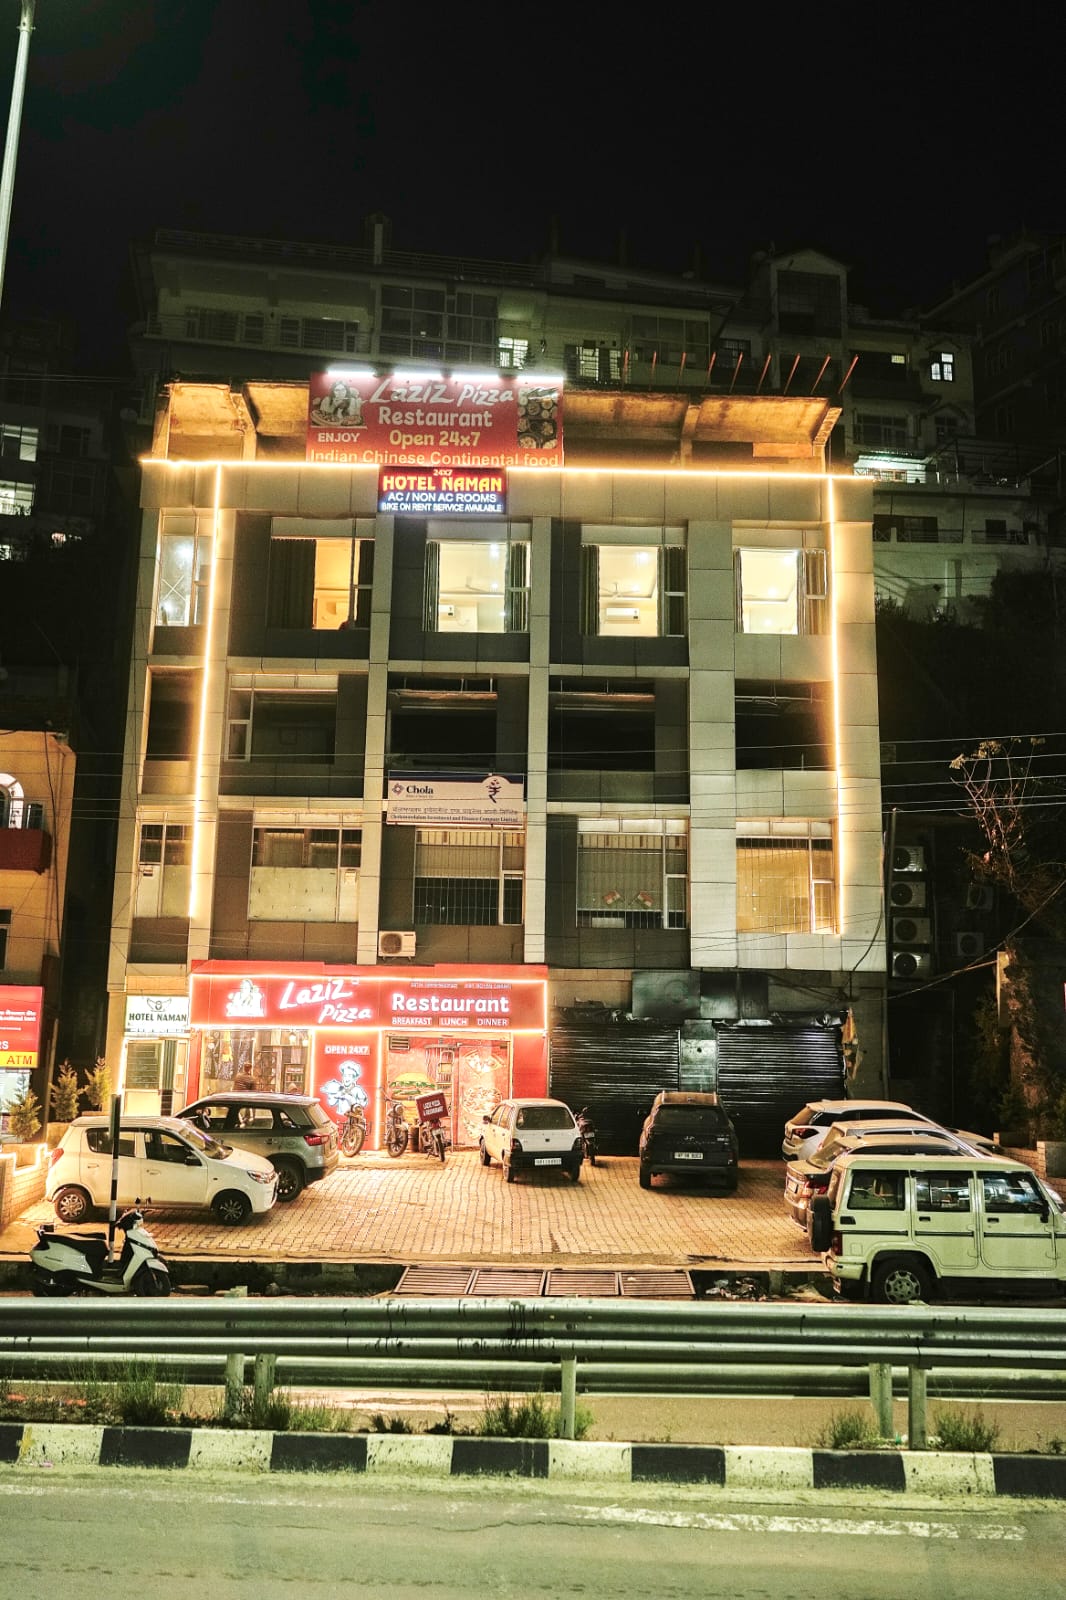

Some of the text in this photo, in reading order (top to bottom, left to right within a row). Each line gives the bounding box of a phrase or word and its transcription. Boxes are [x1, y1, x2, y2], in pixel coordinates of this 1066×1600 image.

[456, 383, 514, 407] Pizza
[379, 406, 493, 427] Restaurant
[318, 432, 360, 443] ENJOY
[389, 430, 481, 449] Open 24x7
[310, 449, 559, 467] Indian Chinese Continental food
[382, 476, 502, 492] HOTEL NAMAN
[387, 492, 404, 502] AC
[412, 493, 436, 503] NON
[438, 493, 454, 503] AC
[456, 493, 498, 503] ROOMS
[400, 503, 411, 511] ON
[412, 503, 432, 512] RENT
[433, 503, 464, 512] SERVICE
[465, 503, 503, 513] AVAILABLE
[406, 785, 434, 795] Chola
[391, 993, 510, 1012] Restaurant
[128, 1013, 187, 1022] HOTEL NAMAN
[317, 1003, 372, 1024] Pizza
[392, 1017, 508, 1026] BREAKFAST LUNCH DINNER
[325, 1046, 347, 1055] OPEN
[6, 1055, 33, 1065] ATM
